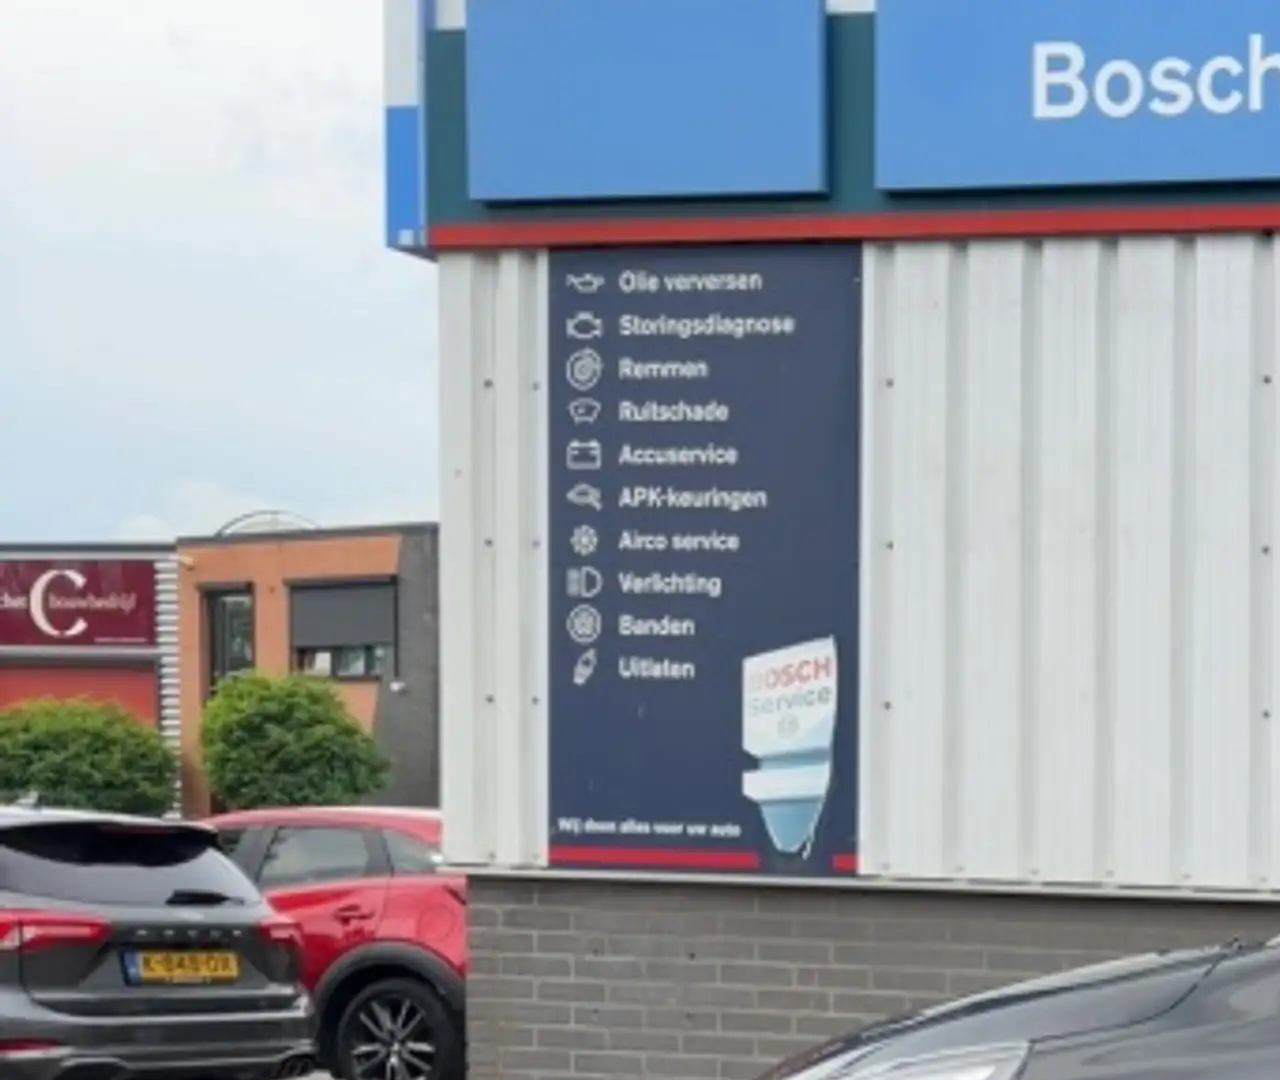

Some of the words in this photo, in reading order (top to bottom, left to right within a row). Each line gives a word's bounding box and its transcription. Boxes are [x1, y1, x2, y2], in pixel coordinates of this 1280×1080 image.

[618, 269, 660, 293] Olie
[664, 273, 763, 292] verversen
[618, 313, 796, 339] Storingsdiagnose
[618, 356, 709, 380] Remmen
[618, 400, 729, 422] Ruitschade
[618, 441, 738, 466] Accuservice
[618, 485, 767, 512] APK-keuringen
[618, 529, 668, 551] Airco
[671, 528, 740, 551] service
[617, 570, 722, 598] Verlichting
[618, 614, 695, 636] Banden
[618, 656, 695, 679] Uitlaten
[749, 656, 833, 693] BOSCH
